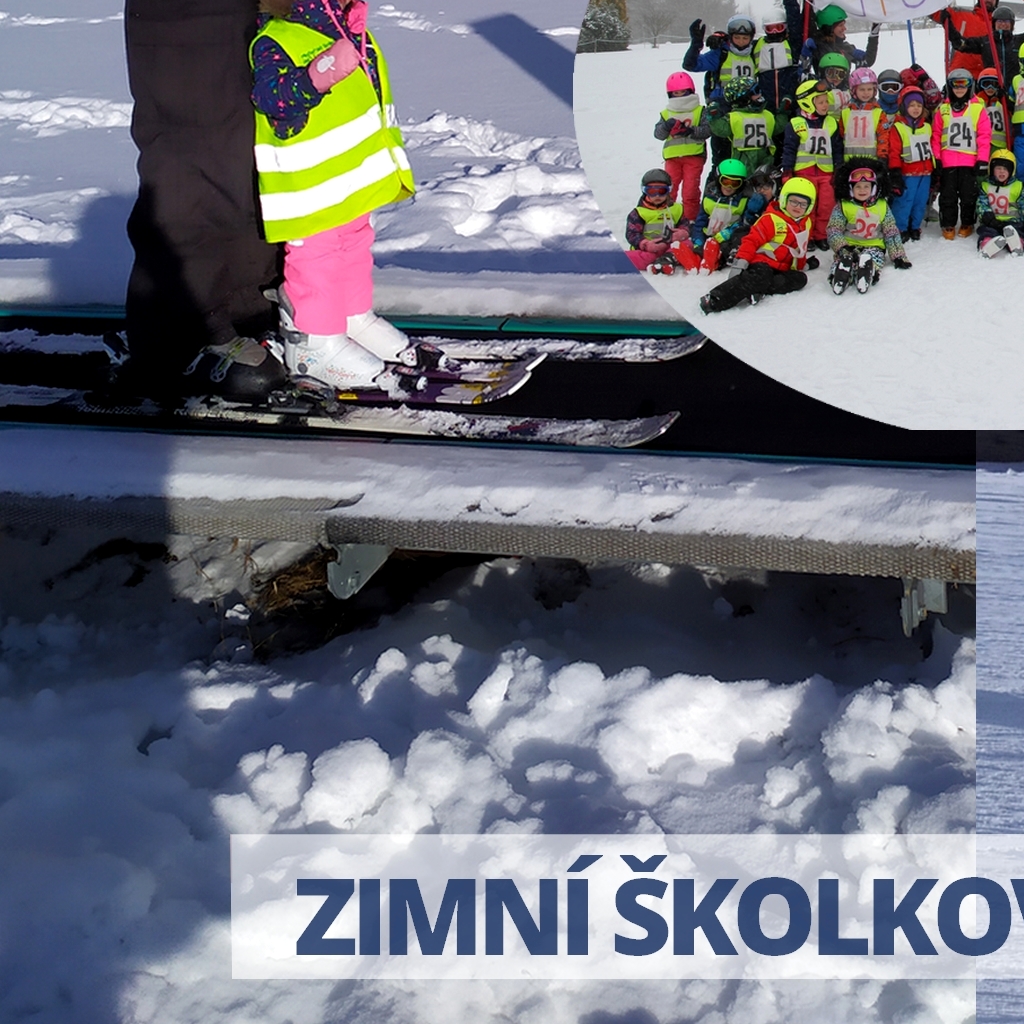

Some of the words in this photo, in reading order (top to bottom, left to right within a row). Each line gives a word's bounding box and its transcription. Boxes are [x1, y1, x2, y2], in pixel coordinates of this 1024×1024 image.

[852, 115, 868, 138] 11
[988, 110, 1004, 131] 13
[745, 124, 767, 148] 25
[810, 135, 827, 155] 16
[949, 122, 973, 147] 24
[914, 141, 932, 161] 15
